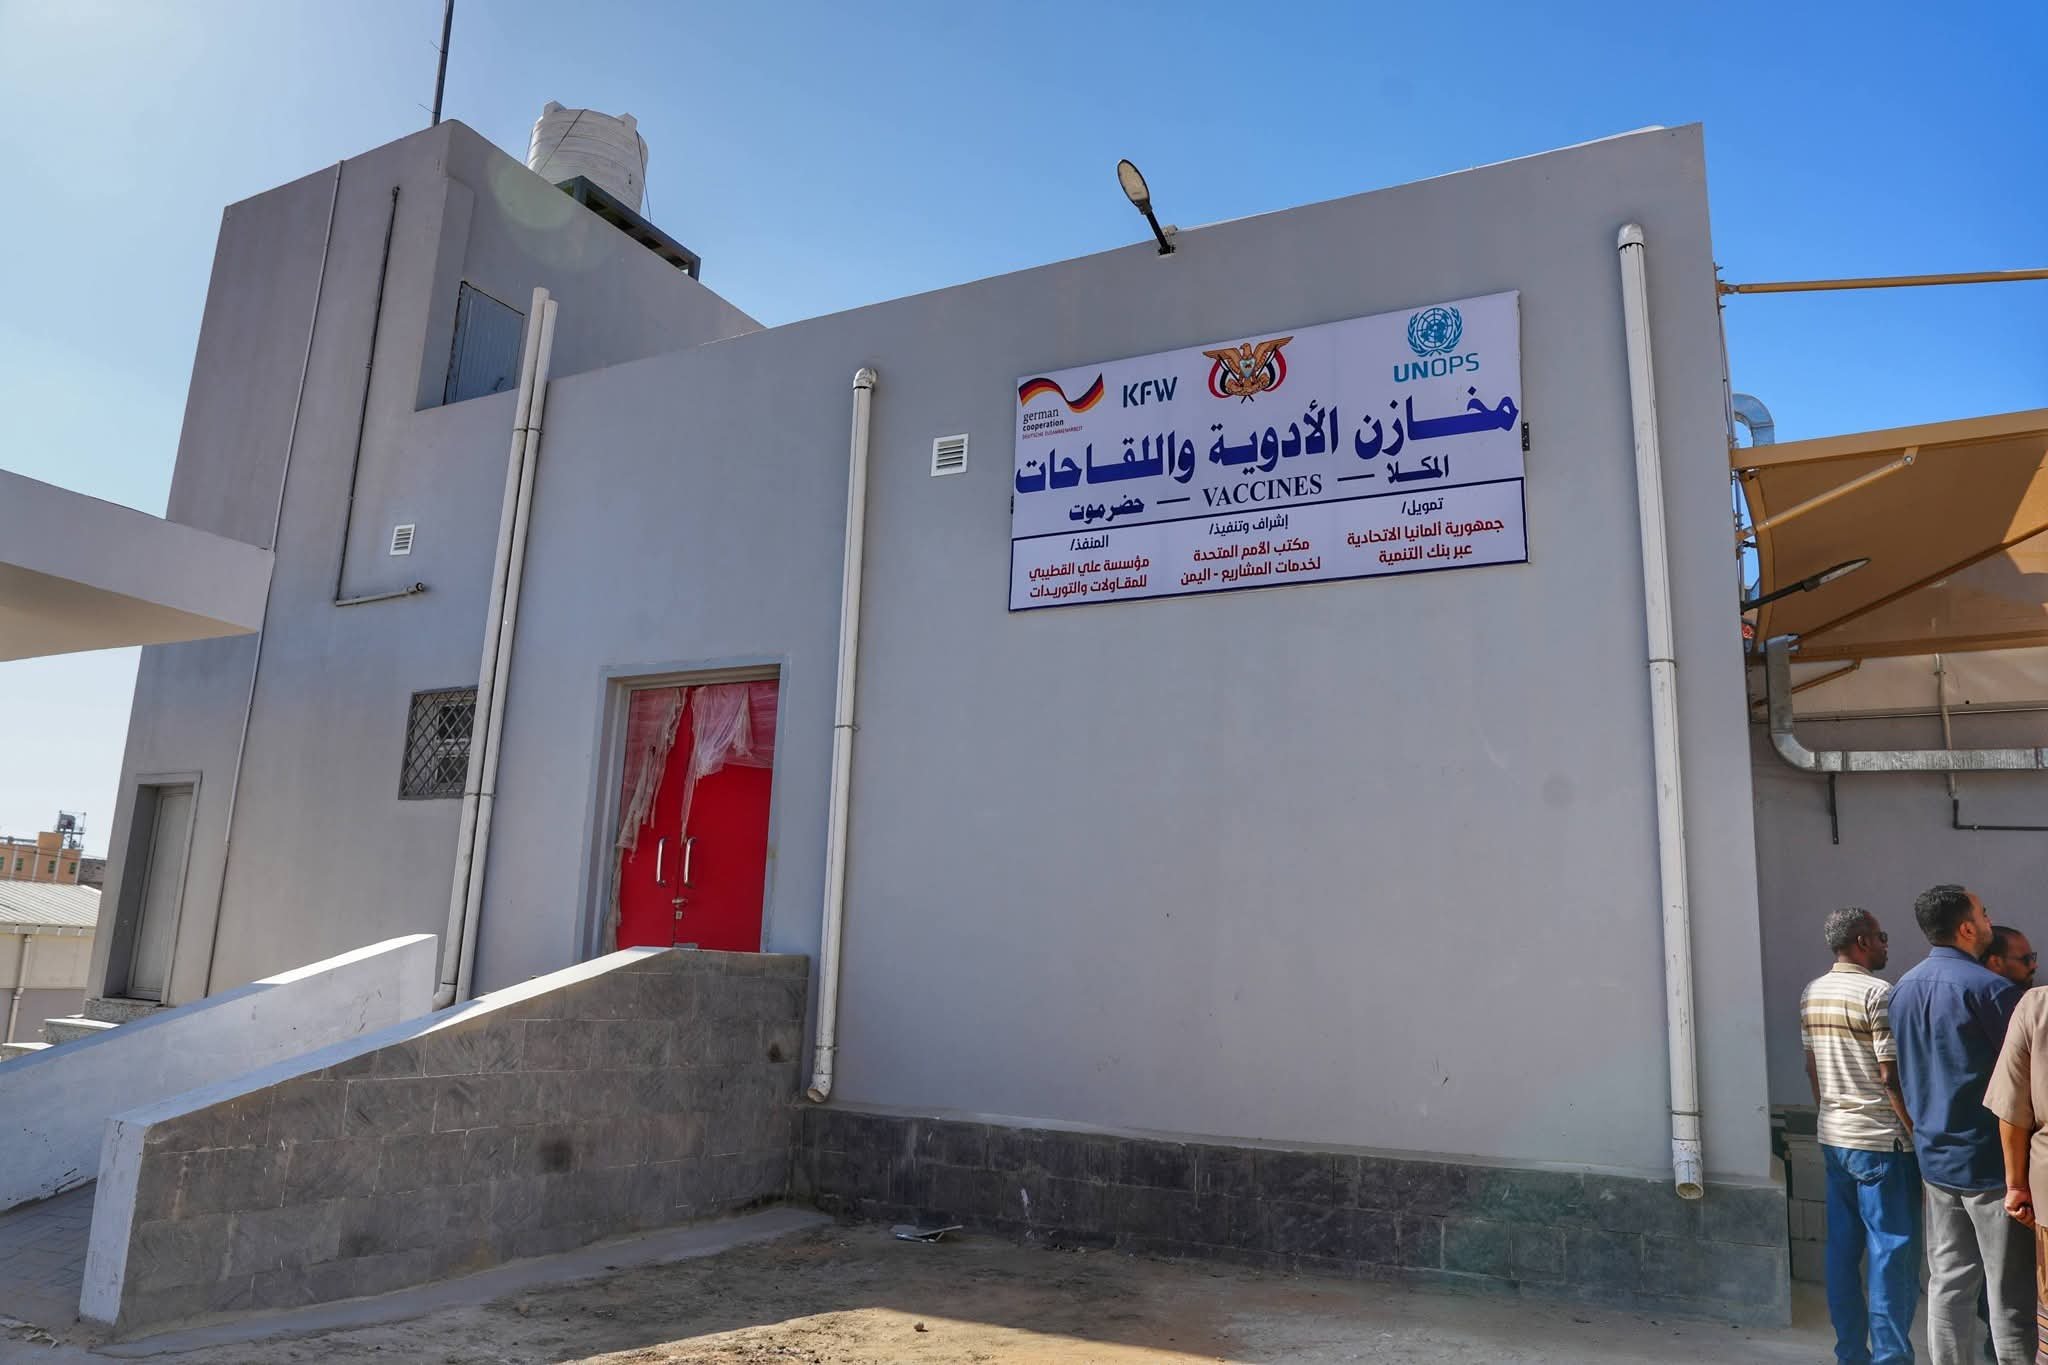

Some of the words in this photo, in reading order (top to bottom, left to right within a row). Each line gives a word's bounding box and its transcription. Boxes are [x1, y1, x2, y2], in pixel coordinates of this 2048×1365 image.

[1393, 353, 1480, 383] UNOPS
[1123, 376, 1178, 408] KFW
[1022, 419, 1064, 432] cooperation
[1023, 408, 1059, 424] german
[1355, 386, 1519, 460] مخازن
[1209, 400, 1339, 475] الأدوية
[1015, 430, 1196, 494] واللقاحات
[1386, 454, 1449, 484] المكلا
[1202, 474, 1323, 507] VACCINES
[1069, 494, 1145, 524] حضرموت
[1252, 513, 1289, 531] إشراف
[1445, 519, 1504, 537] جمهورية
[1347, 527, 1401, 548] الاتحادية
[1193, 544, 1238, 562] المتحدة
[1241, 541, 1270, 560] الأمم
[1274, 538, 1310, 557] مكتب
[1379, 545, 1423, 566] التنمية
[1426, 543, 1450, 560] بنك
[1453, 544, 1473, 560] عبر
[1103, 555, 1150, 572] مؤسسة
[1221, 561, 1272, 583] المشاريع
[1275, 556, 1321, 574] لخدمات
[1090, 575, 1148, 593] للمقاولات
[1180, 567, 1211, 586] اليمن
[1029, 581, 1088, 599] والتوريدات
